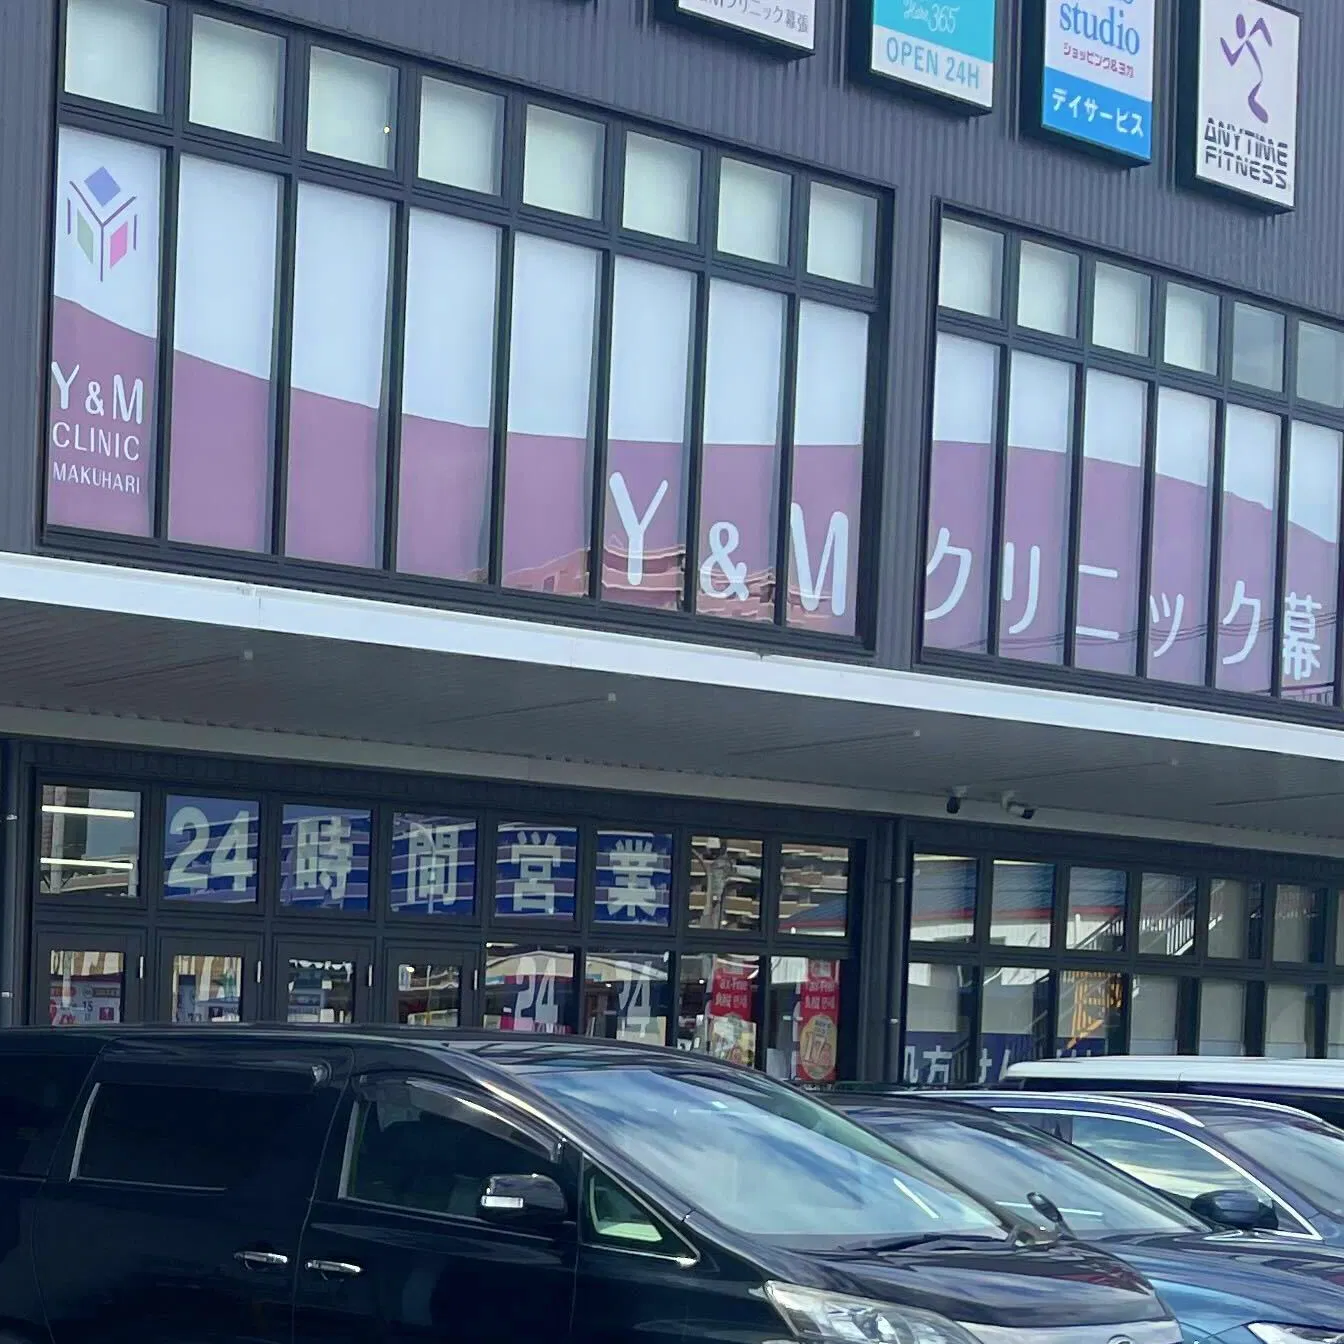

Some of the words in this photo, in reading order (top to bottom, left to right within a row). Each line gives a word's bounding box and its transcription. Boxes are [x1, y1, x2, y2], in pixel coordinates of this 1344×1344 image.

[1059, 2, 1140, 55] studio
[886, 36, 939, 77] OPEN
[945, 56, 980, 89] 24H
[1051, 87, 1144, 137] デイサービス
[1204, 117, 1288, 167] ANYTIME
[1205, 145, 1287, 190] FITNESS
[52, 420, 140, 463] CLINIC
[52, 462, 141, 495] MAKUHARI
[167, 805, 659, 922] 24時間営業
[514, 957, 558, 1033] 24
